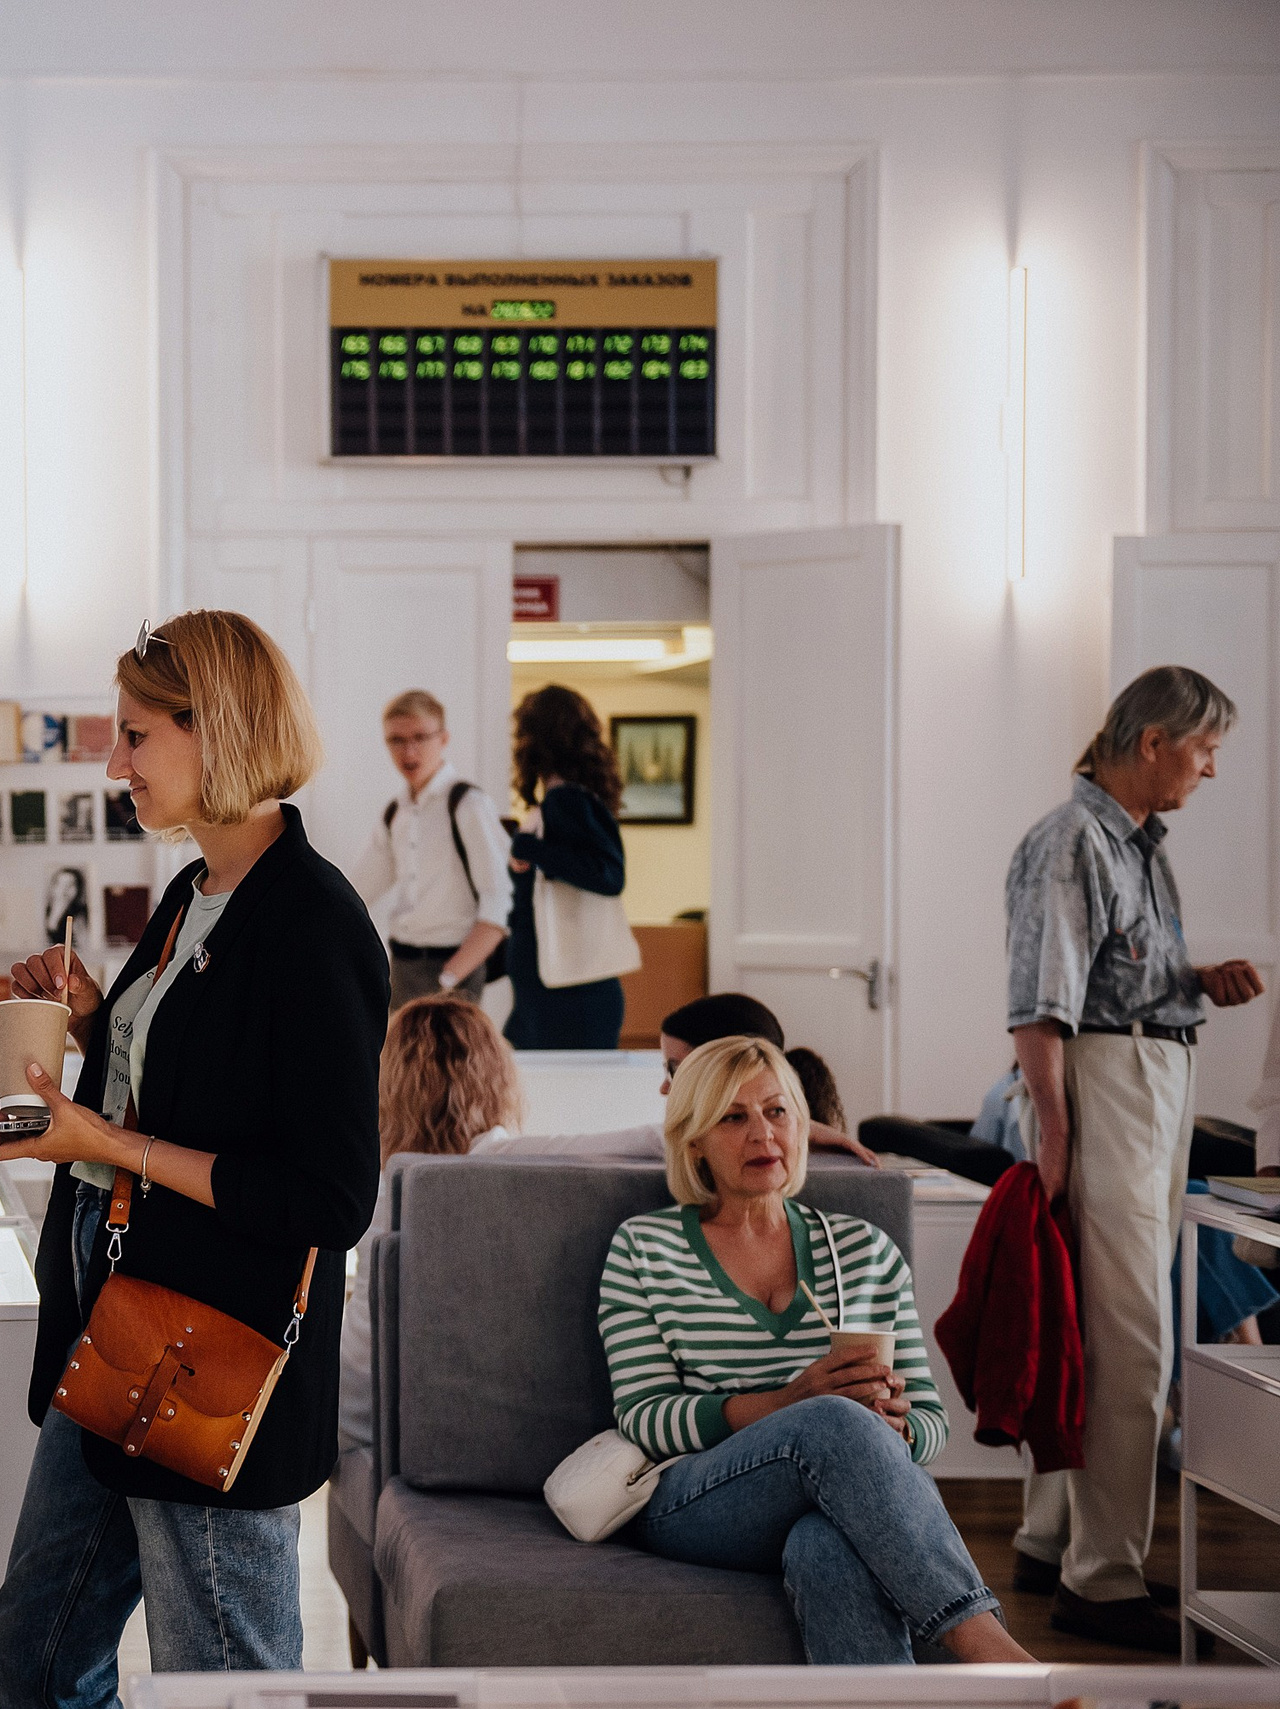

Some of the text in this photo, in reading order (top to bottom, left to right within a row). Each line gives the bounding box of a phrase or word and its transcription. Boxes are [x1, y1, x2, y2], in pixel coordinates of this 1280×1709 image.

[359, 273, 692, 287] НОМЕРА ВЫПОЛНЕННЫХ ЗАКАЗОВ
